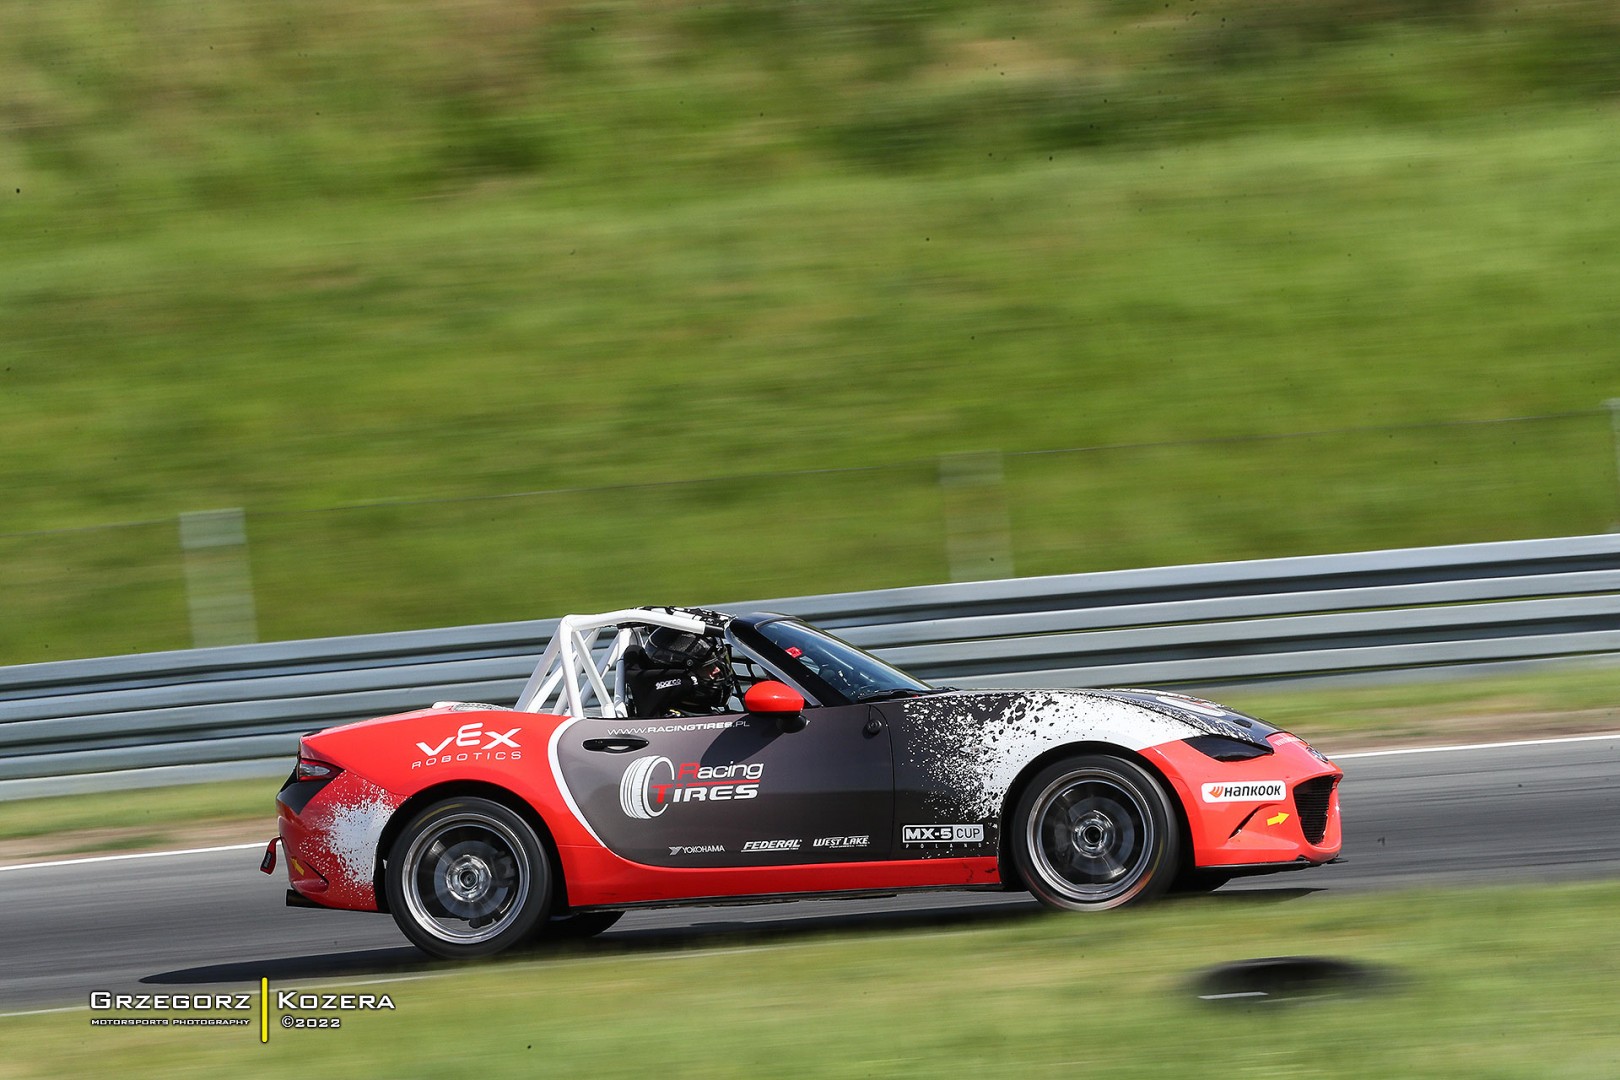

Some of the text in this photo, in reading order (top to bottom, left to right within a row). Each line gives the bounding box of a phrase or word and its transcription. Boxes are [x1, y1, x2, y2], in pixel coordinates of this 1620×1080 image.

[607, 720, 750, 736] WWW.RACINGTIRES.PL
[416, 722, 522, 757] VEX
[411, 751, 522, 770] ROBOTICS
[678, 760, 765, 781] Racing
[905, 827, 980, 840] MX-5 CUP
[681, 845, 726, 854] YOKOHAMA
[743, 839, 801, 850] FEDERAL
